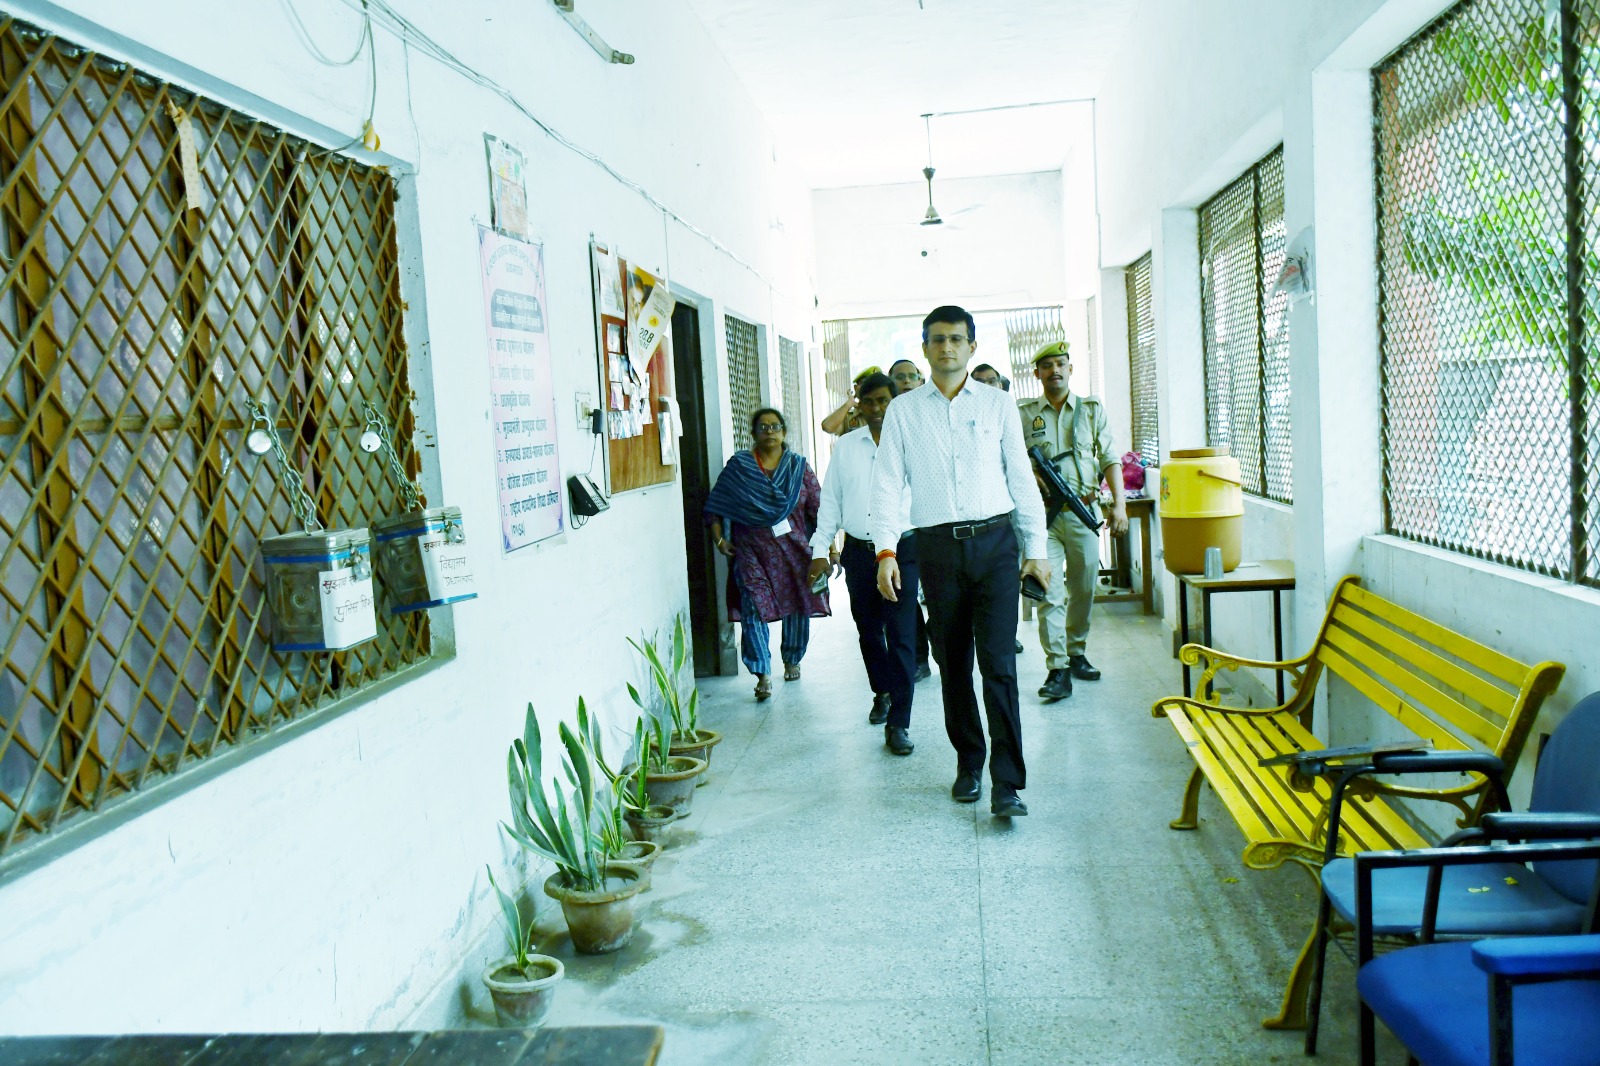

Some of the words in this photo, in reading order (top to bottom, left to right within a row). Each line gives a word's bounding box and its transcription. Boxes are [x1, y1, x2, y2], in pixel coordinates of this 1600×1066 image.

[522, 339, 535, 354] योजना
[522, 365, 535, 380] योजना
[518, 391, 531, 407] योजना
[502, 417, 520, 439] मुख्यमंत्री
[535, 416, 547, 431] योजना
[498, 449, 503, 462] 5.
[544, 441, 555, 456] योजना
[507, 473, 520, 489] प्रोजेक्ट
[536, 468, 547, 483] योजना
[502, 504, 508, 517] 7.
[509, 498, 522, 517] राष्ट्रीय
[521, 495, 536, 512] माध्यमिक
[537, 492, 546, 509] शिक्षा
[547, 489, 559, 506] अभियान
[333, 599, 359, 623] पुलिस
